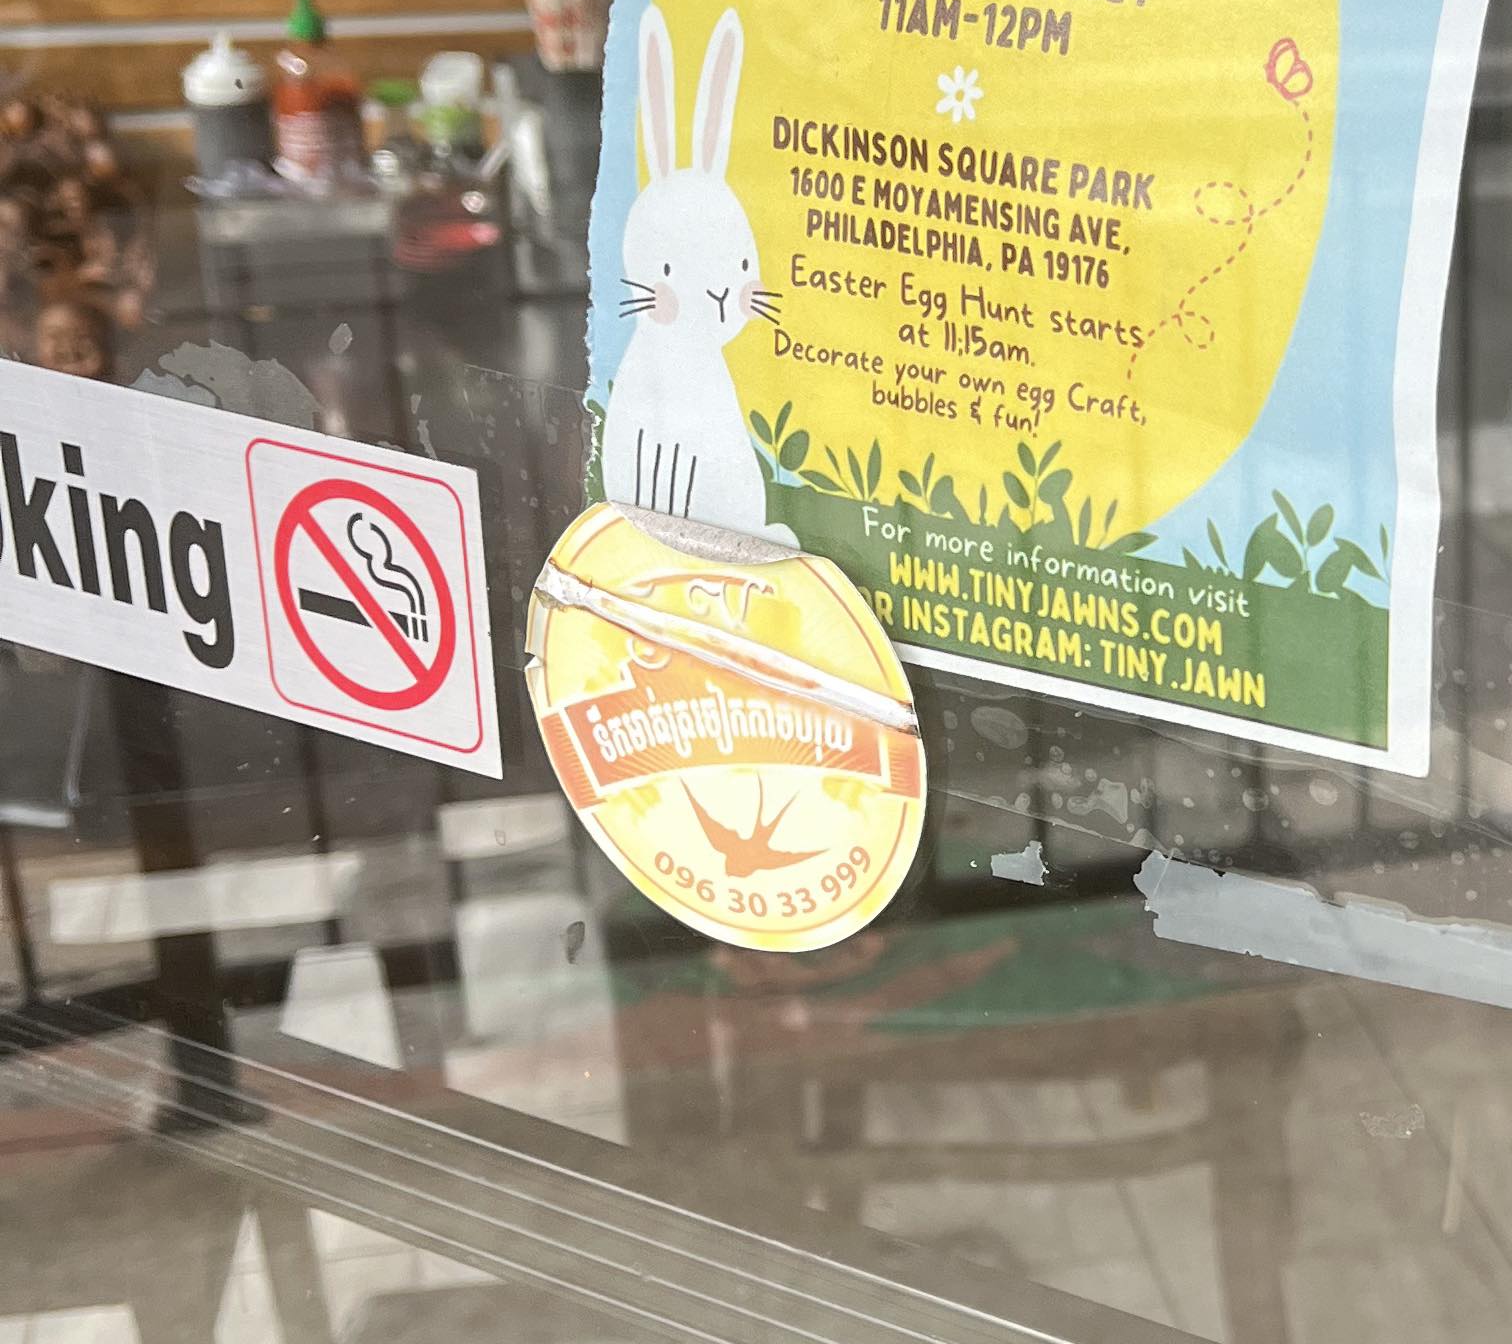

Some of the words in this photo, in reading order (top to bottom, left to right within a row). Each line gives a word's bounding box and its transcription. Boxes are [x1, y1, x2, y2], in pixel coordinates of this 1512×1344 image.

[773, 116, 928, 174] DICKINSON
[938, 142, 1059, 195] SQUARE
[1068, 163, 1155, 211] PARK
[791, 166, 844, 202] 1600
[852, 175, 866, 206] E
[874, 179, 1060, 240] MOYAMENSING
[791, 254, 887, 300] Easter
[901, 272, 948, 319] Egg
[961, 284, 1034, 328] Hunt
[1050, 310, 1144, 347] starts
[1002, 242, 1034, 277] PA
[1044, 250, 1110, 289] 19176
[774, 328, 884, 375] Decorate
[894, 361, 947, 385] your
[959, 373, 1005, 396] own
[1016, 383, 1055, 413] egg
[1068, 382, 1147, 425] Craft,
[899, 322, 930, 348] at
[872, 380, 957, 420] bubbles
[970, 400, 982, 425] &
[994, 404, 1041, 437] fun!
[0, 432, 235, 669] king
[862, 506, 911, 544] For
[925, 525, 994, 562] more
[1007, 541, 1175, 600] information
[1188, 580, 1251, 618] visit
[889, 552, 1223, 655] WWW.TINYJAWNS.COM
[903, 596, 1092, 668] INSTAGRAM:
[654, 851, 716, 903] 096
[728, 889, 768, 917] 30
[777, 888, 817, 917] 33
[820, 846, 871, 902] 999
